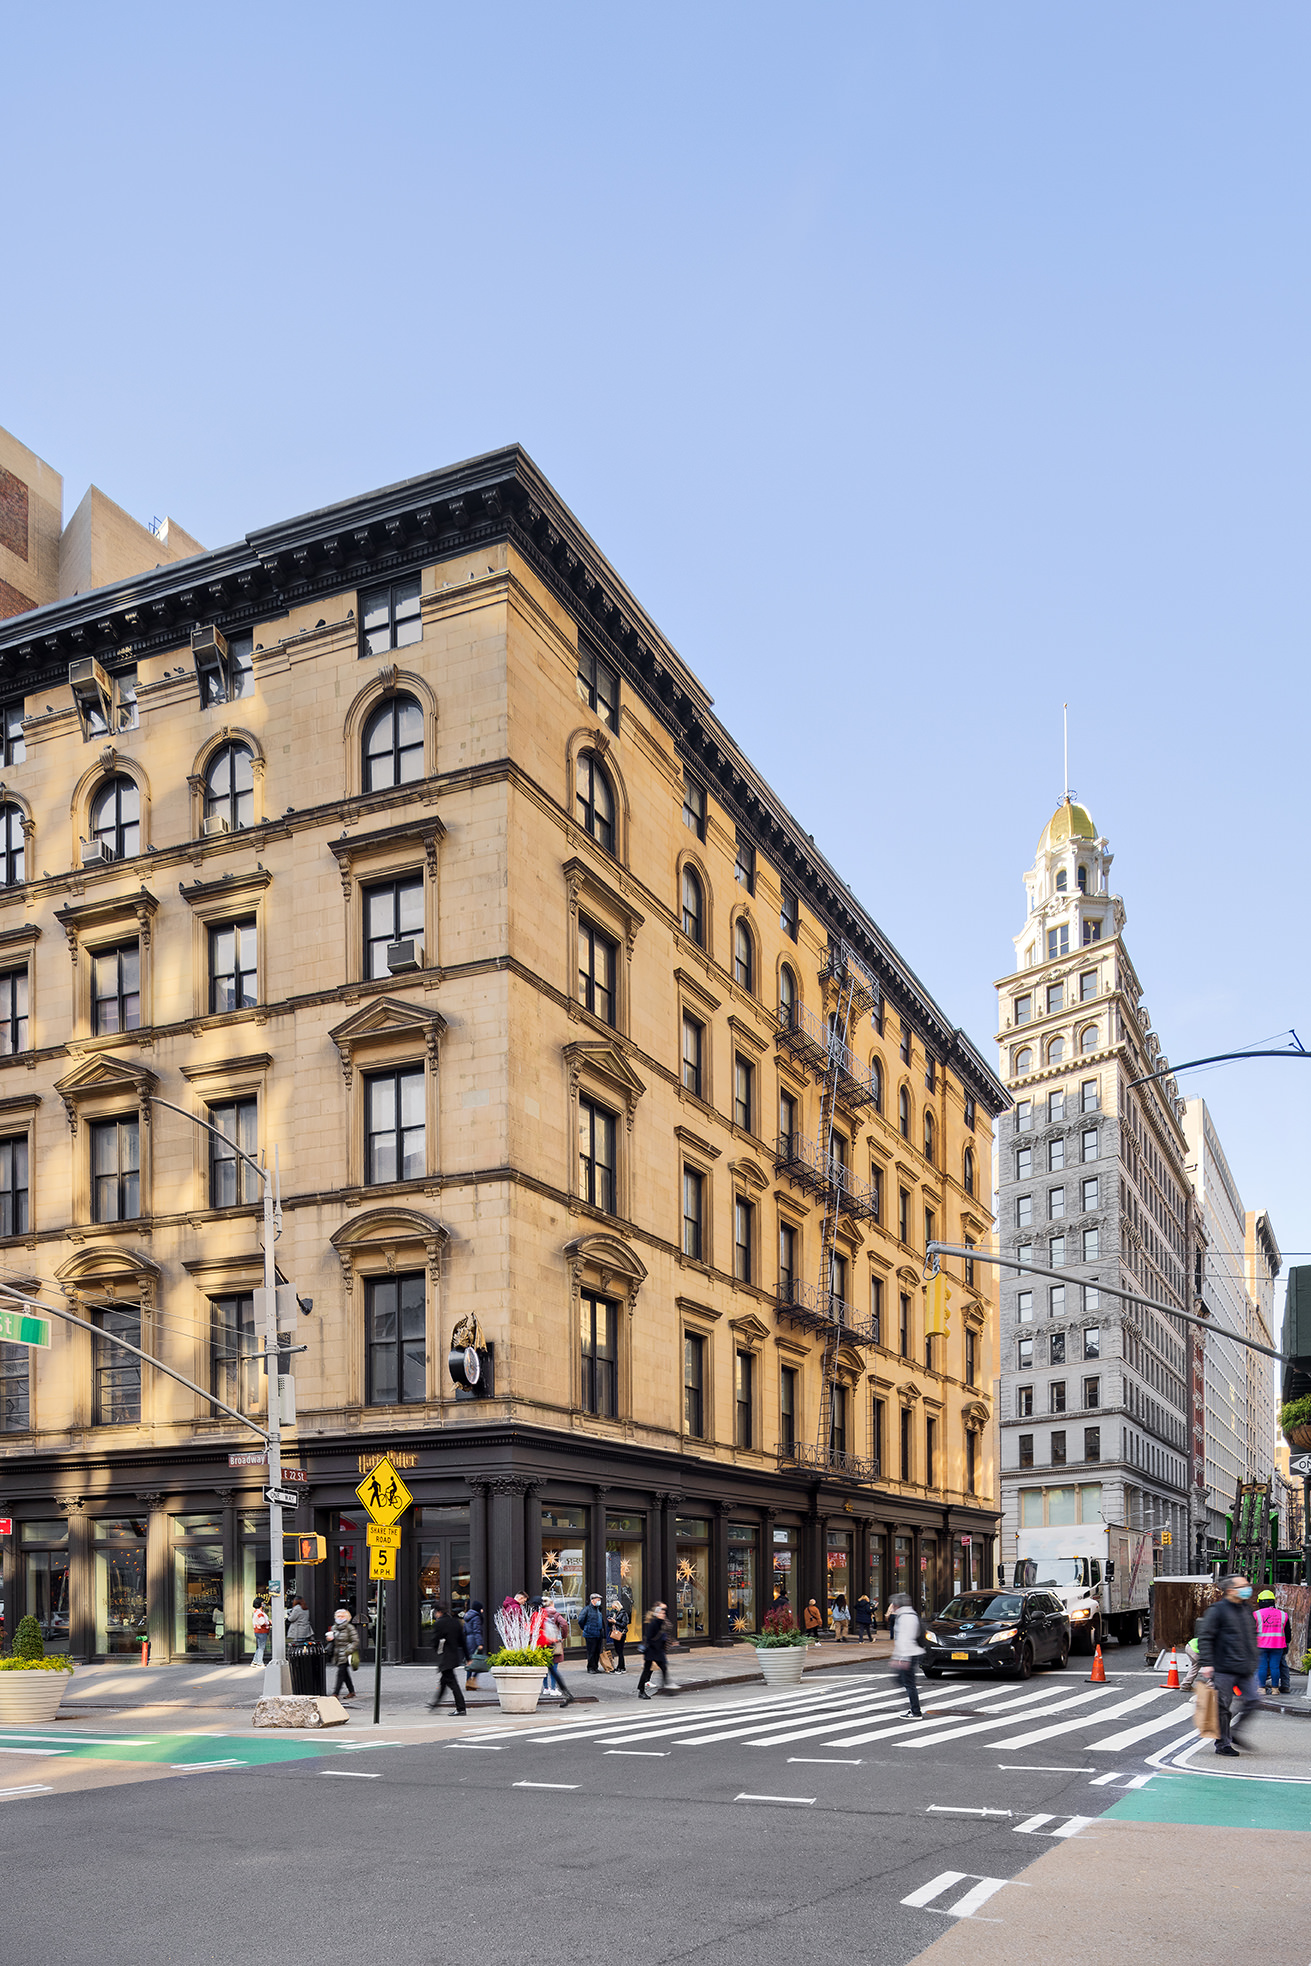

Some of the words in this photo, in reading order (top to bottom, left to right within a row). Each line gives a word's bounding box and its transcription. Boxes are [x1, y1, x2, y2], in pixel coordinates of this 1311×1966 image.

[0, 1316, 12, 1335] t
[230, 1454, 266, 1465] Broadway
[284, 1470, 288, 1479] E
[289, 1471, 296, 1480] 22
[270, 1491, 281, 1500] ONE
[370, 1526, 387, 1535] SHARE
[388, 1528, 398, 1536] THE
[375, 1535, 392, 1544] ROAD
[378, 1549, 388, 1566] 5
